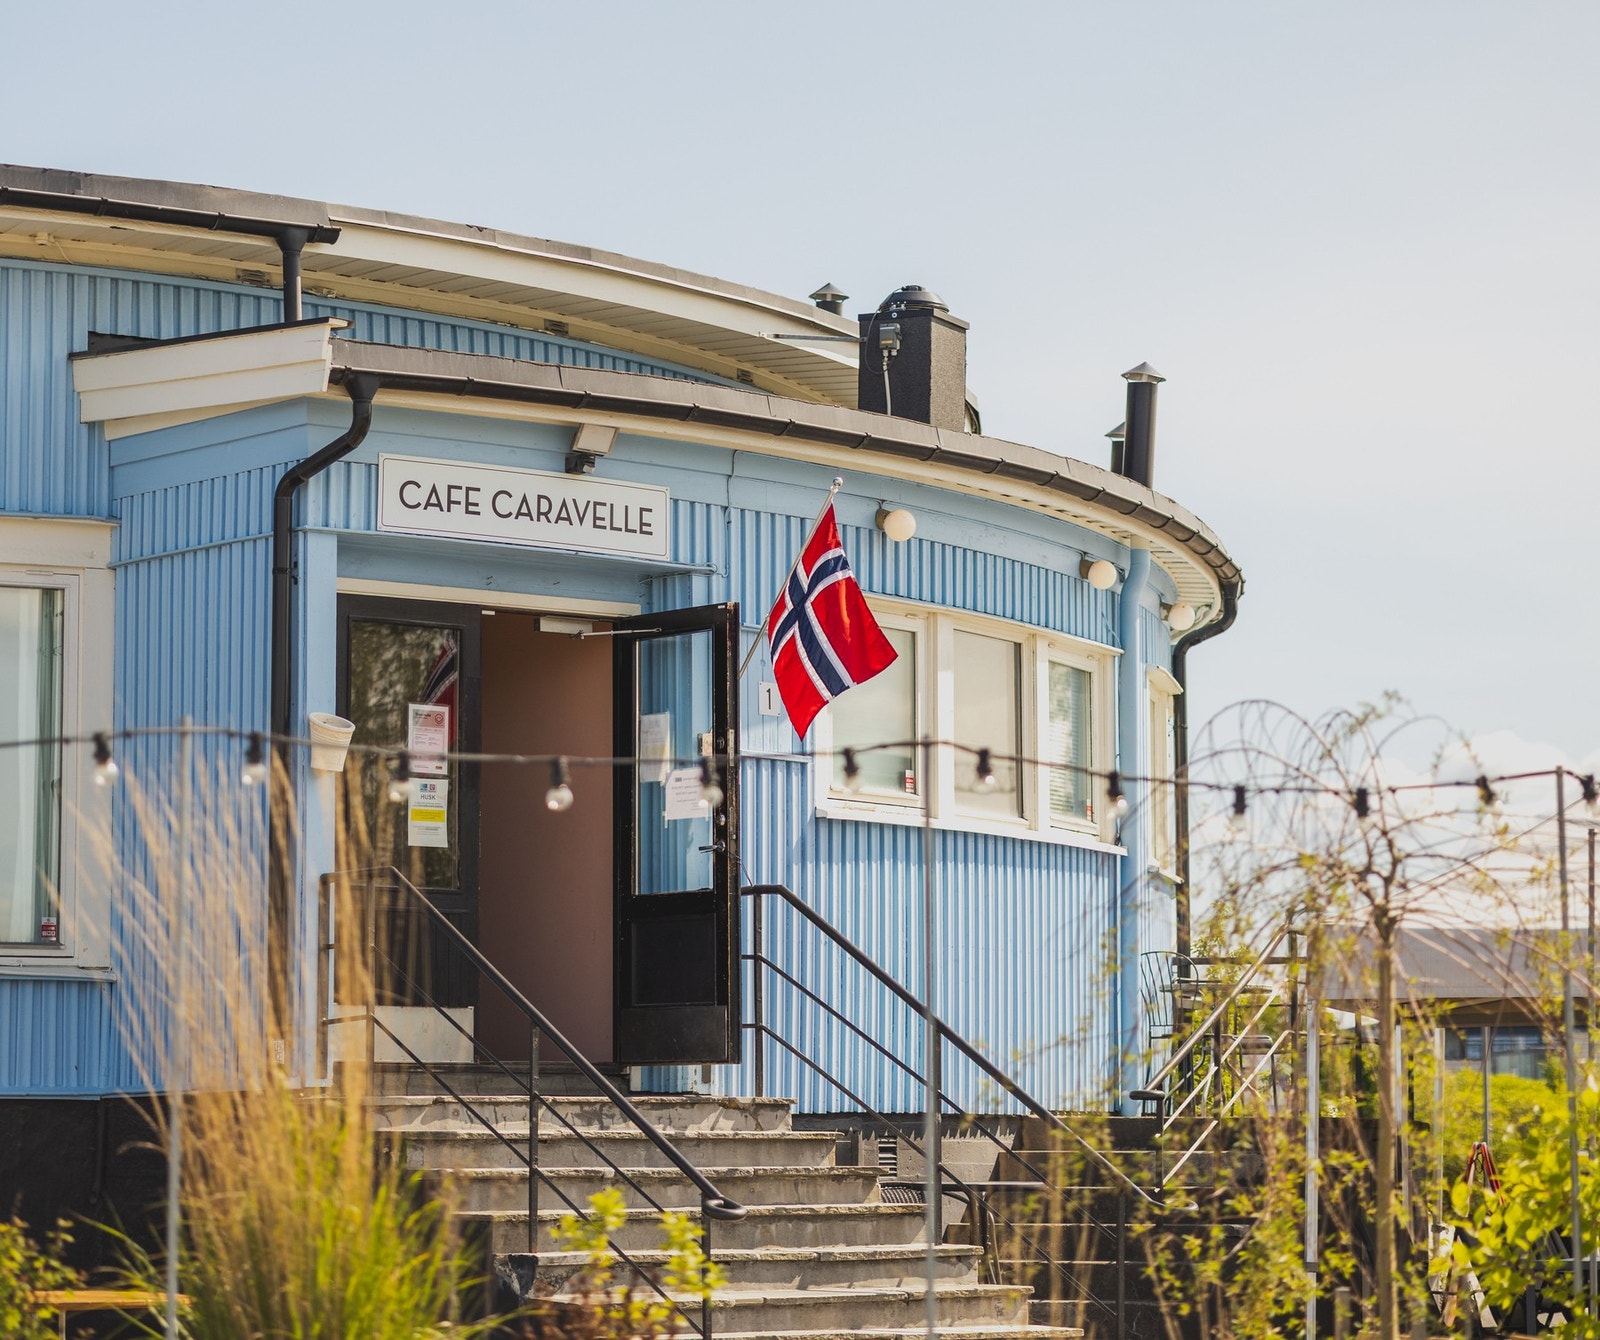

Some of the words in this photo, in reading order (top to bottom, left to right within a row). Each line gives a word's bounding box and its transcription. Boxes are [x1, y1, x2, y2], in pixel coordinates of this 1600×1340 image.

[398, 480, 481, 516] CAFE
[491, 489, 654, 536] CARAVELLE
[766, 687, 772, 710] 1
[420, 793, 437, 801] HUSK
